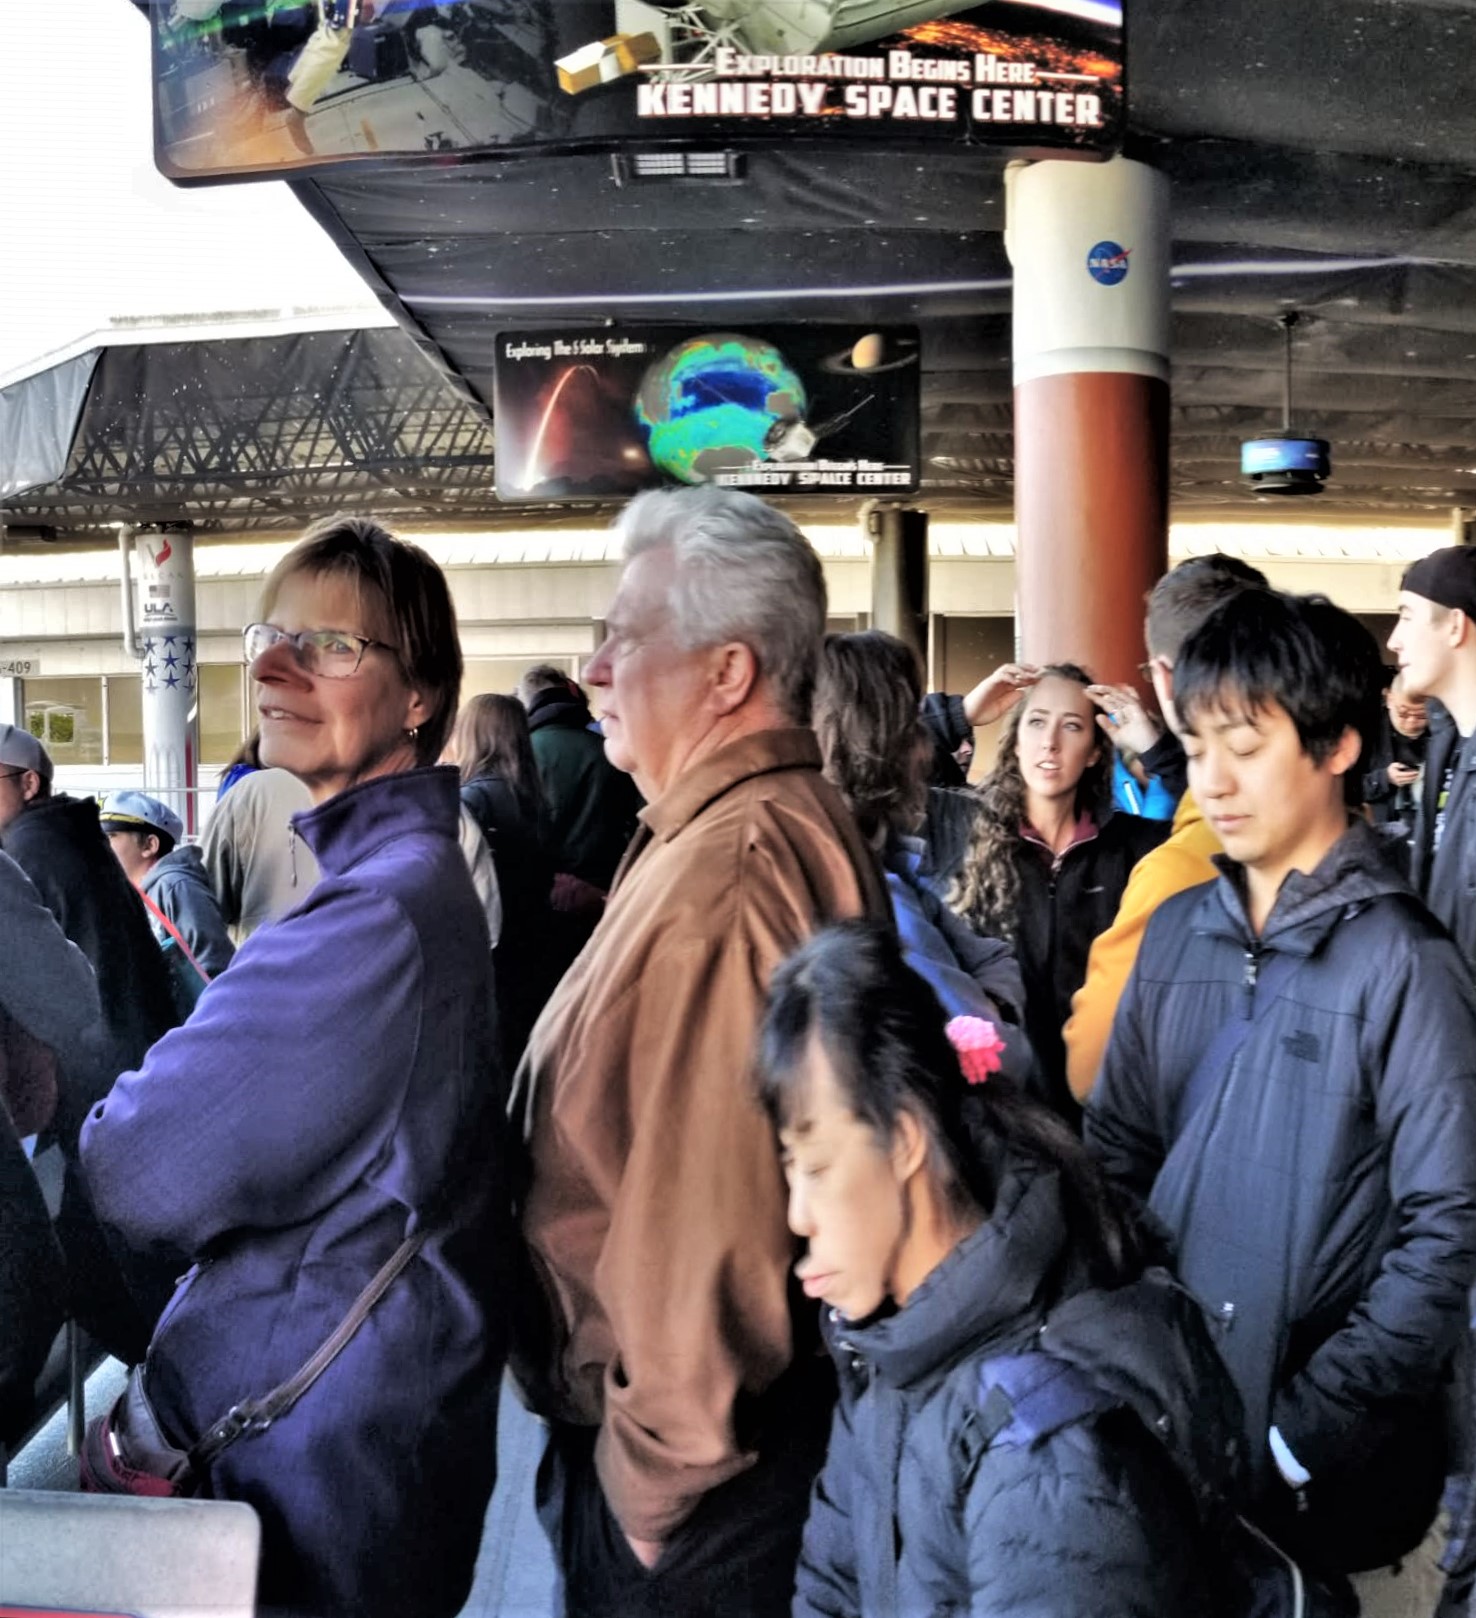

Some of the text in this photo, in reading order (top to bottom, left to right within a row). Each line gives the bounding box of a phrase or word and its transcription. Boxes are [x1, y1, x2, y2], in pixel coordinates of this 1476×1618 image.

[716, 47, 1036, 84] EXPLORATION BEGINS HERE
[637, 82, 1101, 125] KENNEDY SPACE CENTER
[506, 342, 552, 361] Exploring
[797, 473, 852, 486] SPACE
[857, 472, 911, 486] CENTER
[144, 602, 174, 613] ULA
